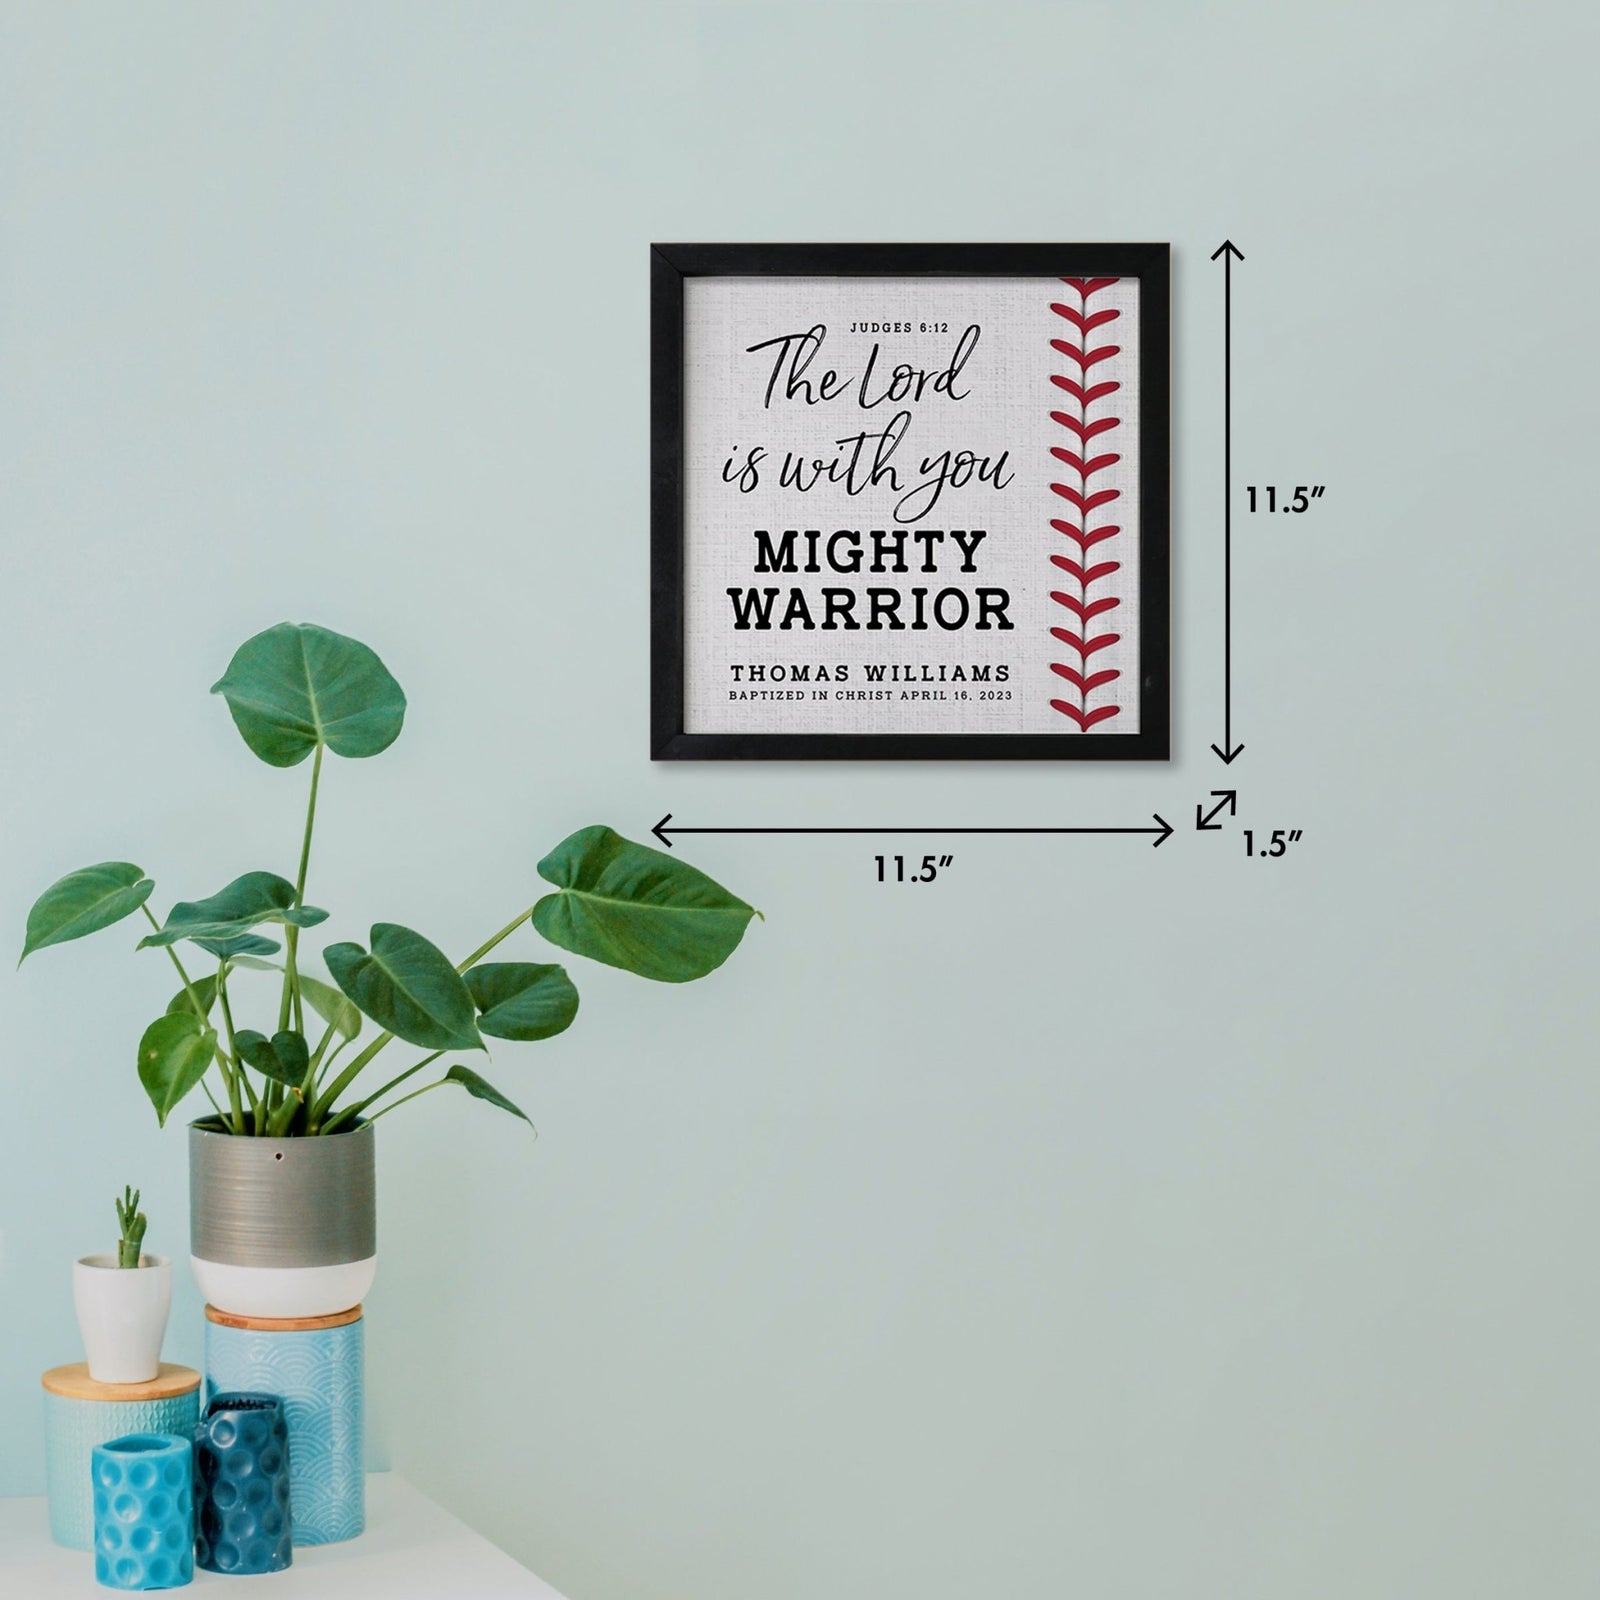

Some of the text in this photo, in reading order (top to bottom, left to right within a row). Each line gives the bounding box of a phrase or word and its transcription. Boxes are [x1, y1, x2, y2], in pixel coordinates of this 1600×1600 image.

[850, 322, 949, 334] JUDGES 6:12
[745, 323, 981, 410] The Lord
[722, 410, 1015, 524] is with you
[753, 529, 987, 574] MIGHTY
[726, 587, 1015, 631] WARRIOR
[730, 664, 1009, 682] THOMAS WILLIAMS
[728, 690, 805, 701] BAPTIZED
[812, 690, 828, 701] IN
[835, 690, 893, 701] CHRIST
[900, 690, 948, 701] APRIL
[979, 690, 1013, 701] 2023
